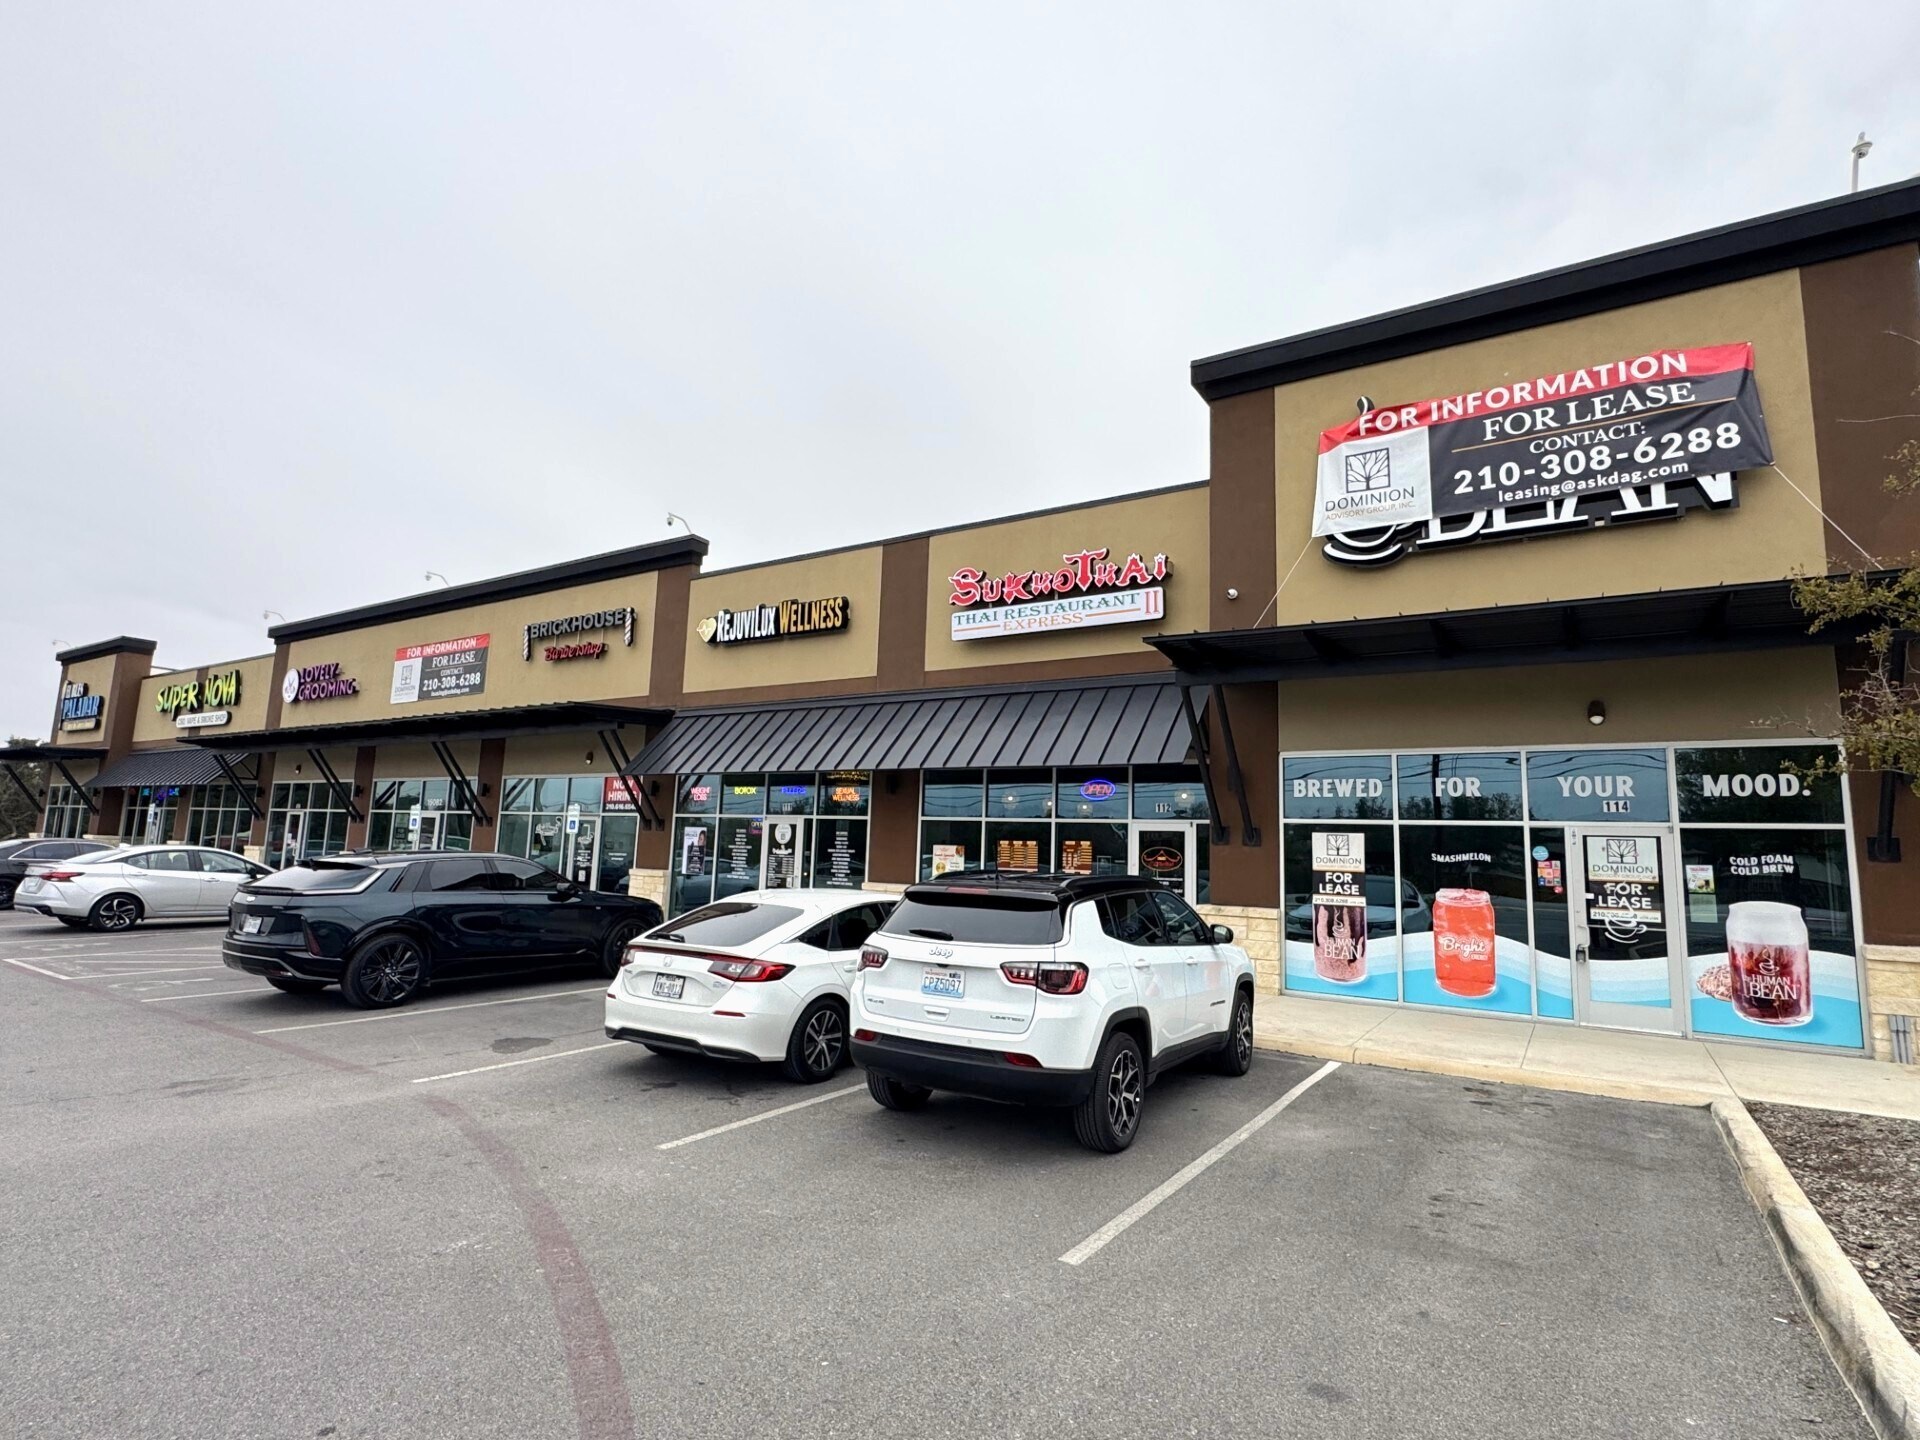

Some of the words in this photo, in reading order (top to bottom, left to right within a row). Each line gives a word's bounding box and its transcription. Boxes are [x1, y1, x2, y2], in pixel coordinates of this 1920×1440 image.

[1358, 410, 1417, 437] FOR
[1431, 352, 1688, 422] INFORMATION
[1483, 406, 1555, 442] FOR
[1567, 382, 1696, 426] LEASE
[1529, 421, 1647, 455] CONTACT:
[1453, 421, 1742, 495] 210-308-6288
[1498, 461, 1689, 503] leasing@askdag.com
[1325, 486, 1415, 512] DOMINION
[1325, 508, 1366, 521] ADVISORY
[948, 547, 1167, 606] SUKHOTHAI
[954, 609, 998, 626] THAI
[1003, 593, 1140, 620] RESTAURANT
[1144, 590, 1161, 615] II
[530, 608, 624, 639] BRICKHOUSE
[716, 604, 777, 642] REJUVILUX
[780, 597, 843, 634] WELLNESS
[1003, 613, 1084, 632] EXPRESS
[406, 647, 421, 659] FOR
[423, 637, 477, 657] INFORMATION
[432, 656, 449, 668] FOR
[449, 650, 476, 665] LEASE
[300, 663, 337, 683] LOVELY
[422, 672, 481, 691] 210-308-6288
[155, 681, 199, 721] SUPER
[203, 670, 237, 706] NOVA
[298, 679, 354, 700] GROOMING
[734, 787, 757, 795] BOTOX
[1083, 784, 1112, 796] OPEN
[1293, 778, 1384, 798] BREWED
[1435, 776, 1483, 798] FOR
[1557, 775, 1636, 797] YOUR
[1703, 773, 1812, 798] MOOD.
[607, 790, 639, 802] HIRIN
[1156, 803, 1171, 813] 112
[1604, 800, 1630, 813] 114
[1315, 857, 1362, 865] DOMINION
[1431, 852, 1491, 863] SMASHMELON
[1729, 856, 1759, 866] COLD
[1761, 854, 1794, 864] FOAM
[1325, 872, 1353, 883] FOR
[1592, 864, 1654, 874] DOMINION
[1730, 866, 1760, 876] COLD
[1762, 865, 1795, 874] BREW
[1319, 883, 1360, 895] LEASE
[1605, 882, 1643, 895] FOR
[1598, 895, 1652, 909] LEASE
[1326, 938, 1356, 947] HUMAN
[1442, 936, 1486, 957] Bright
[928, 946, 954, 959] Jeep
[1324, 944, 1360, 960] BEAN
[923, 976, 962, 993] CPZ5097
[1751, 974, 1791, 985] HUMAN
[1749, 982, 1797, 1000] BEAN
